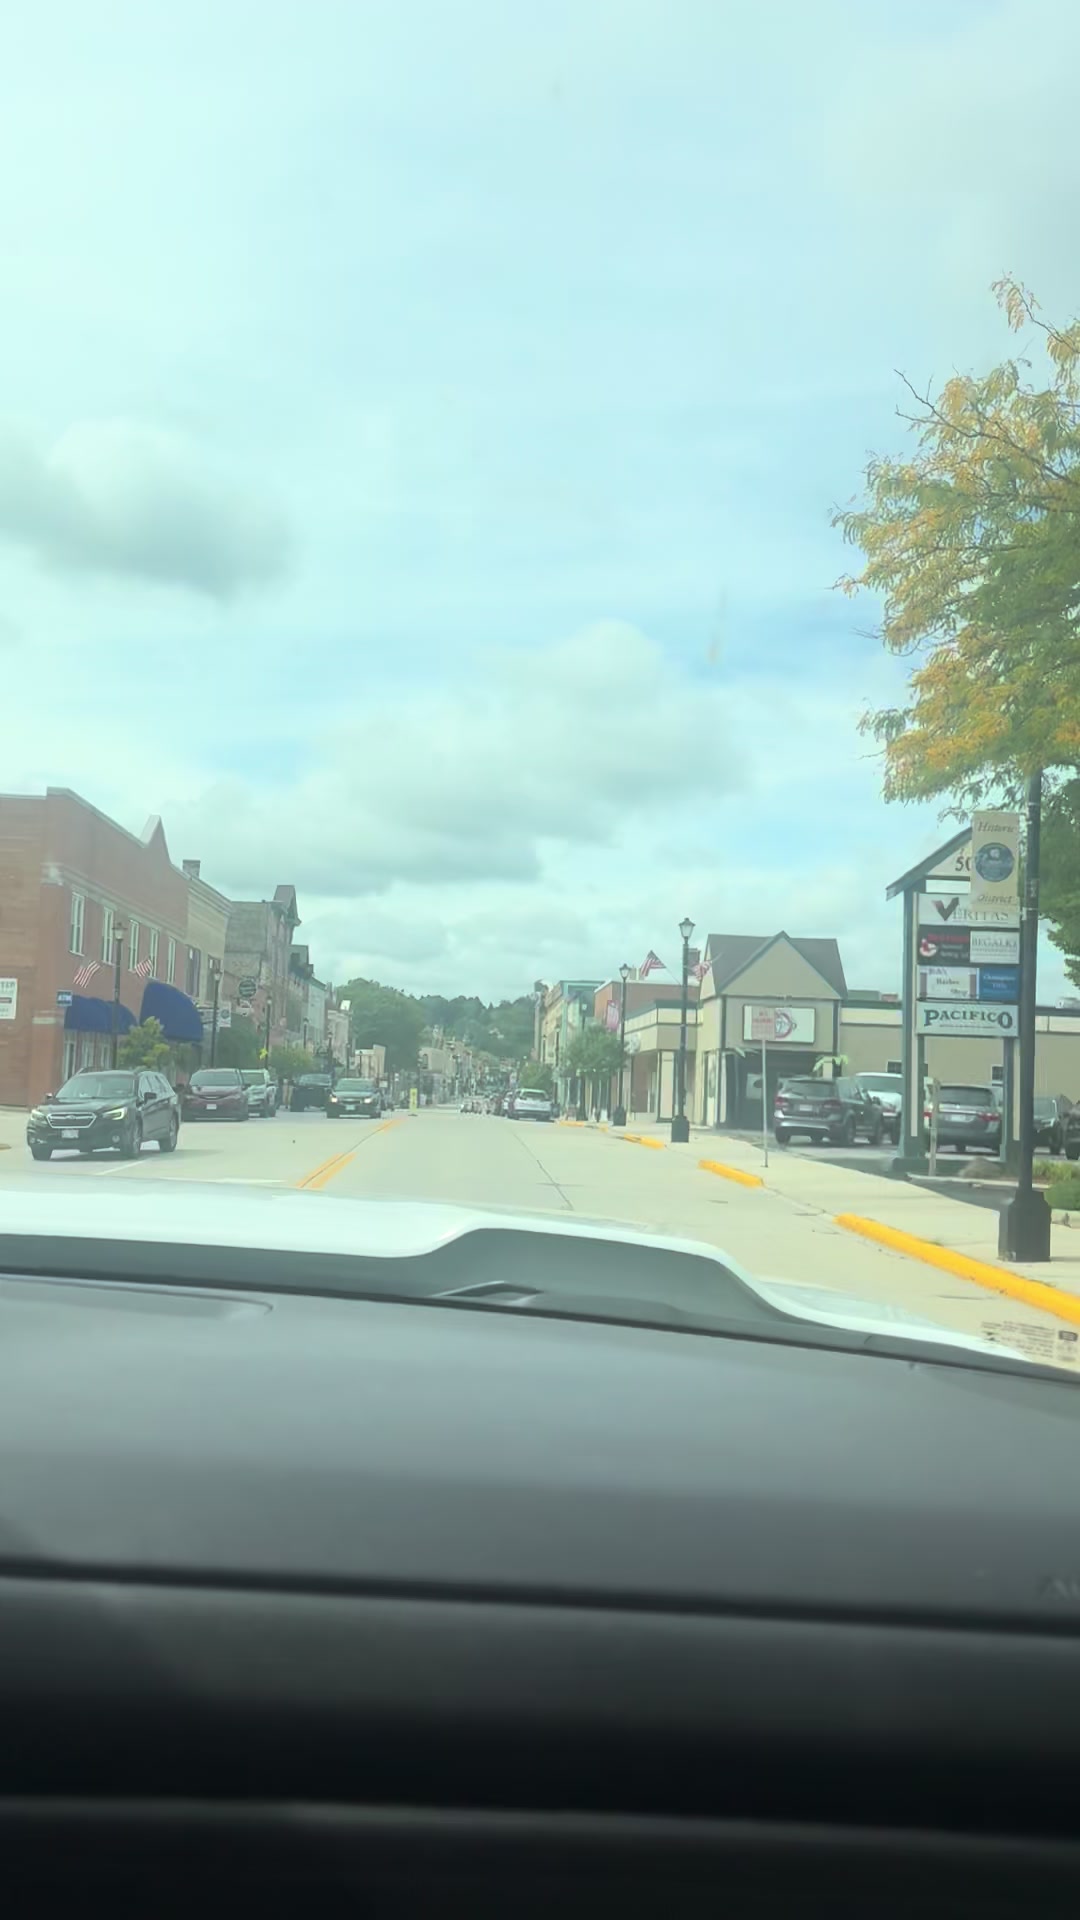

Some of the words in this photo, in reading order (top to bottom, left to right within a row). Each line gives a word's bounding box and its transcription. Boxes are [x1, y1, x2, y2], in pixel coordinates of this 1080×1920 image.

[978, 821, 1015, 833] Historic
[977, 895, 1013, 905] District
[924, 1009, 1013, 1029] PACIFICO
